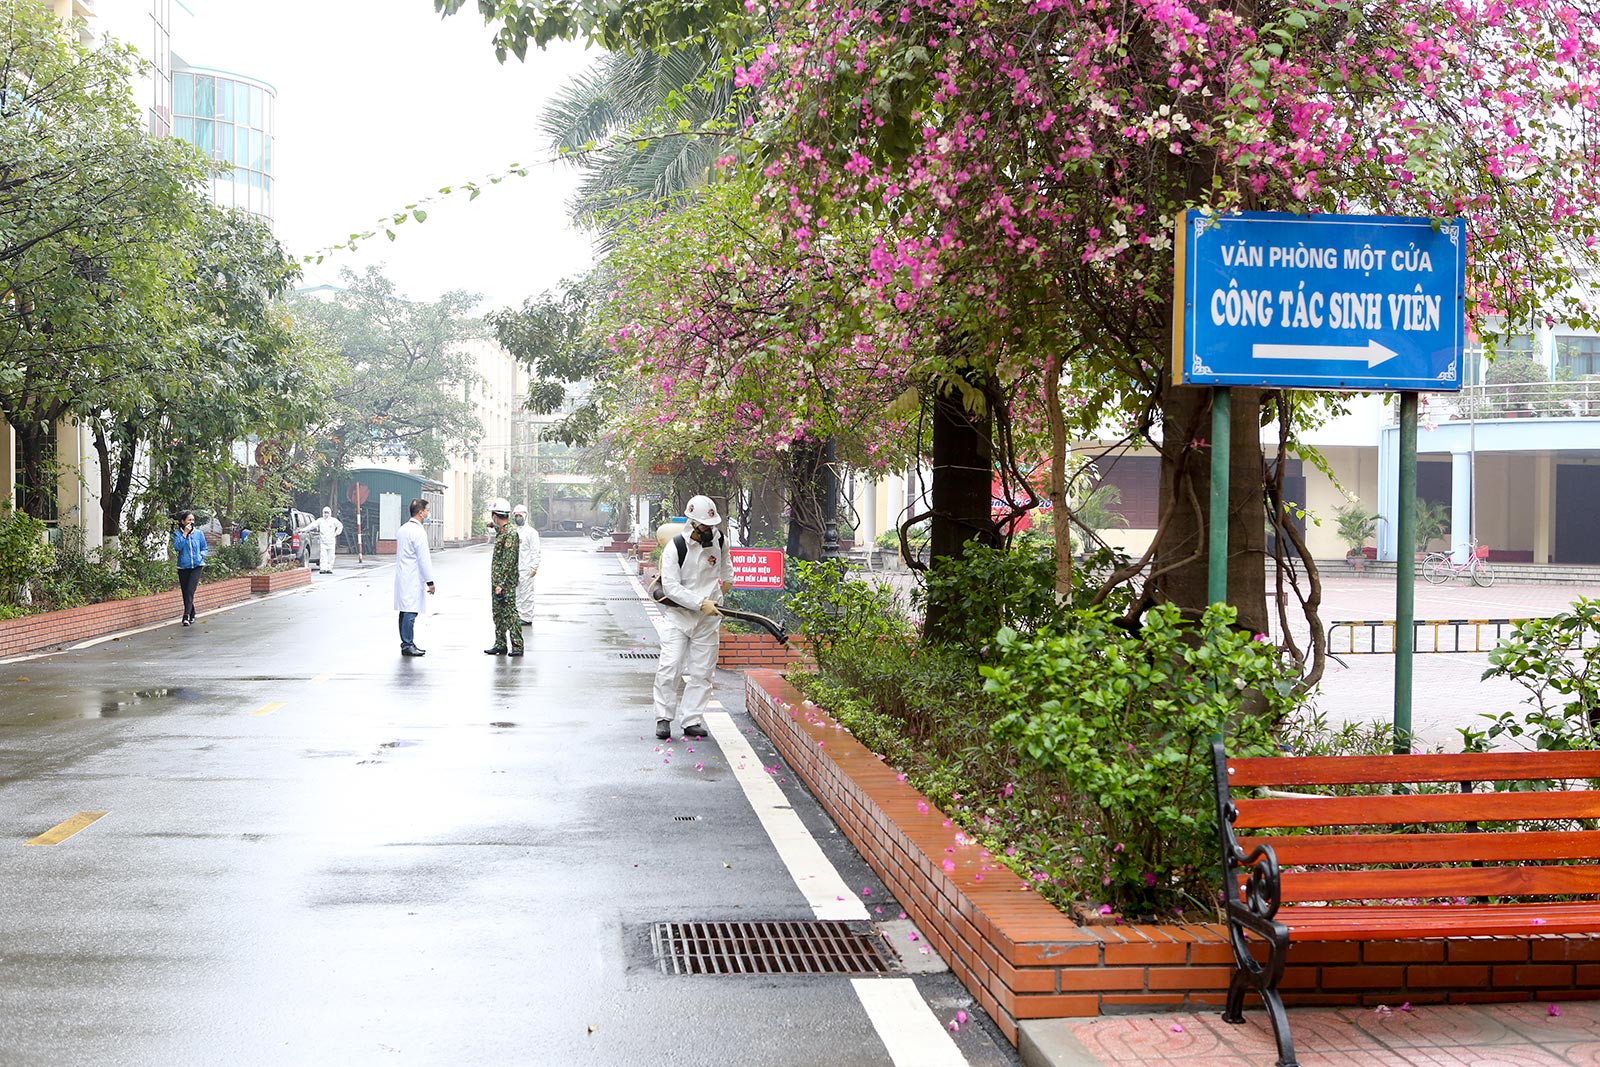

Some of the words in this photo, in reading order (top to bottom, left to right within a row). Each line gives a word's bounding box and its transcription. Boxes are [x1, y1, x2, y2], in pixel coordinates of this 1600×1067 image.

[1220, 240, 1263, 267] VĂN
[1269, 242, 1337, 270] PHÒNG
[1343, 244, 1386, 277] MỘT
[1391, 242, 1433, 272] CỬA
[1210, 278, 1273, 327] CÔNG
[1278, 280, 1324, 328] TÁC
[1329, 292, 1382, 330] SINH
[1388, 283, 1441, 331] VIÊN
[733, 574, 744, 582] ÁCH
